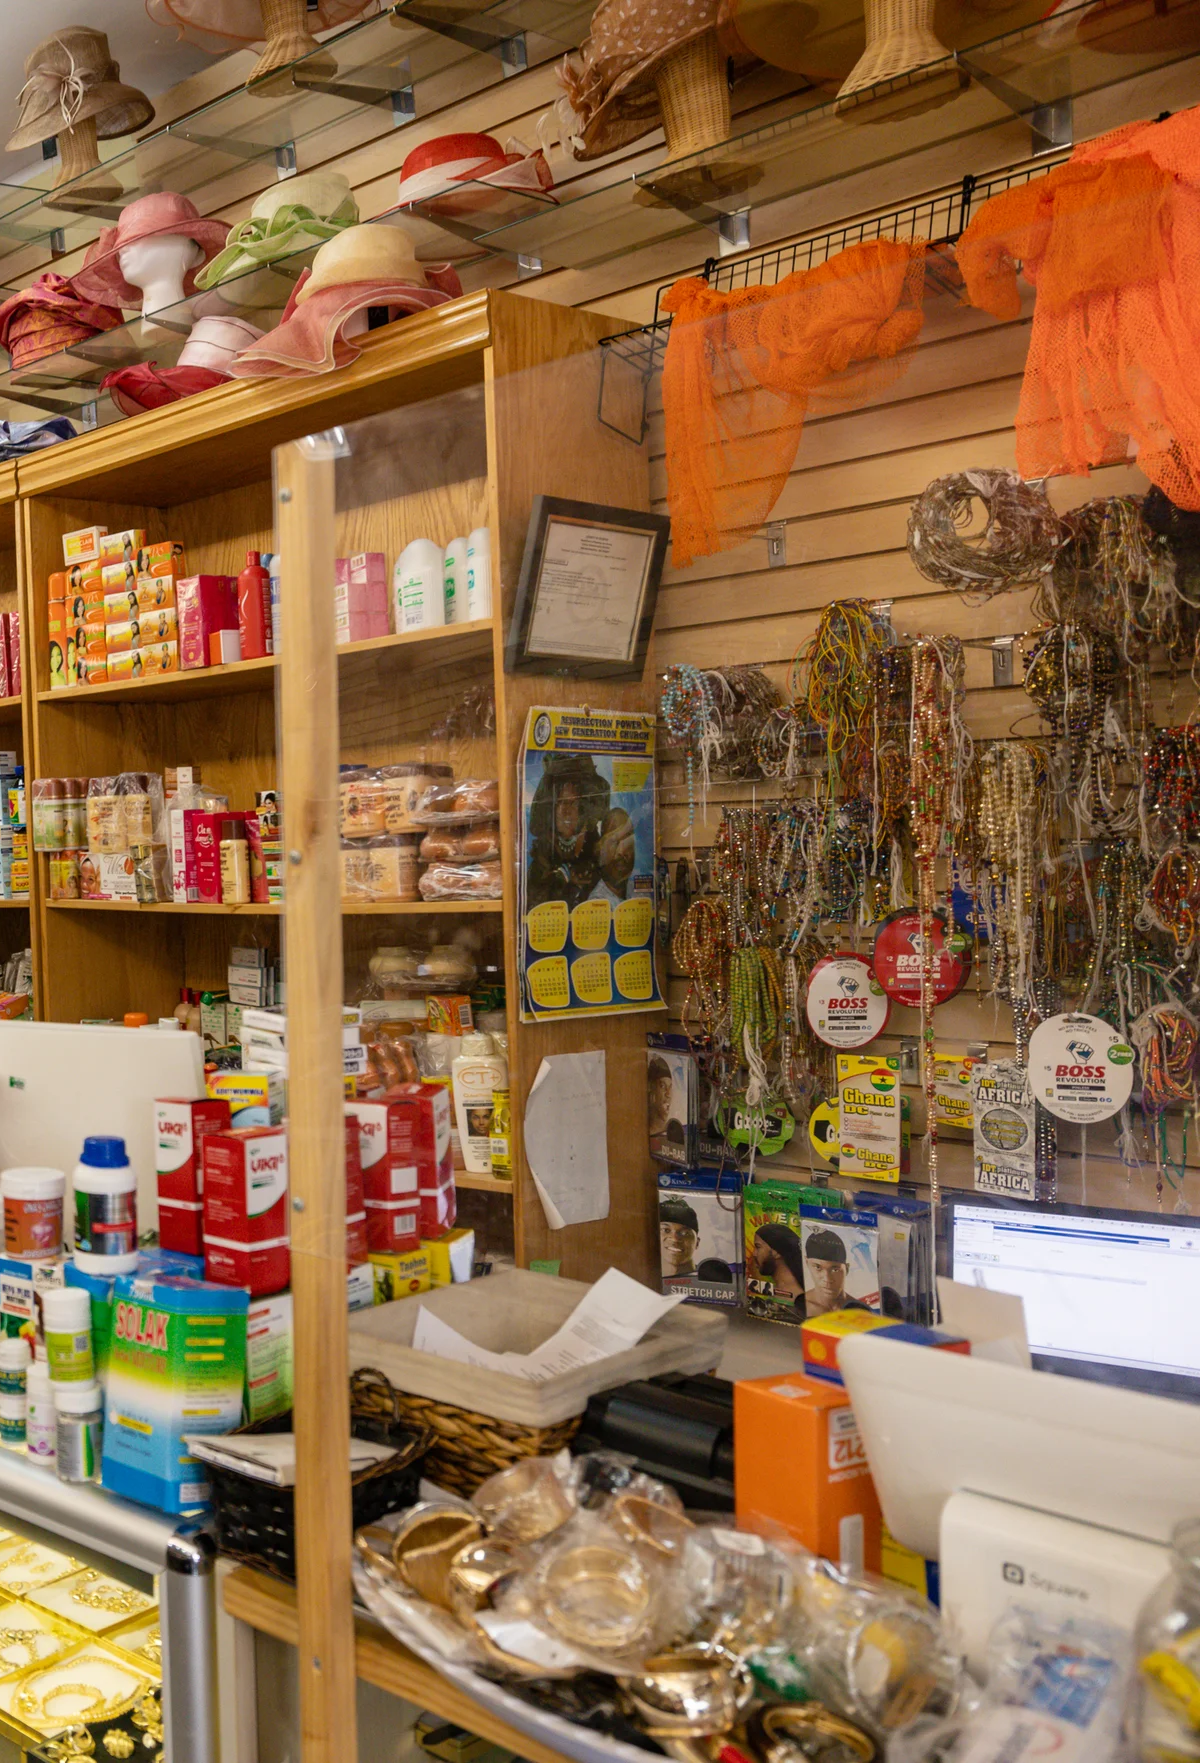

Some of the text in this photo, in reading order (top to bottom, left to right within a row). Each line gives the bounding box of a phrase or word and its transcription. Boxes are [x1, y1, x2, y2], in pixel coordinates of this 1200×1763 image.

[561, 716, 642, 730] RESURRECTION POWER
[555, 726, 649, 740] NEW GENERATION CHURCH
[896, 955, 941, 966] BOS
[828, 998, 868, 1009] BOSS
[461, 1071, 499, 1085] CT+
[1055, 1065, 1106, 1078] BOSS
[981, 1079, 995, 1088] IDT
[843, 1088, 895, 1107] Ghana
[938, 1095, 969, 1110] Ghana
[844, 1105, 869, 1115] DC
[661, 1145, 686, 1161] DU-RAG
[857, 1148, 894, 1164] Ghana
[981, 1163, 1028, 1176] IDT platinum
[979, 1172, 1030, 1191] AFRICA
[750, 1213, 789, 1229] WAVE
[670, 1285, 735, 1300] STRETCH CAP
[115, 1302, 169, 1350] SOLAK
